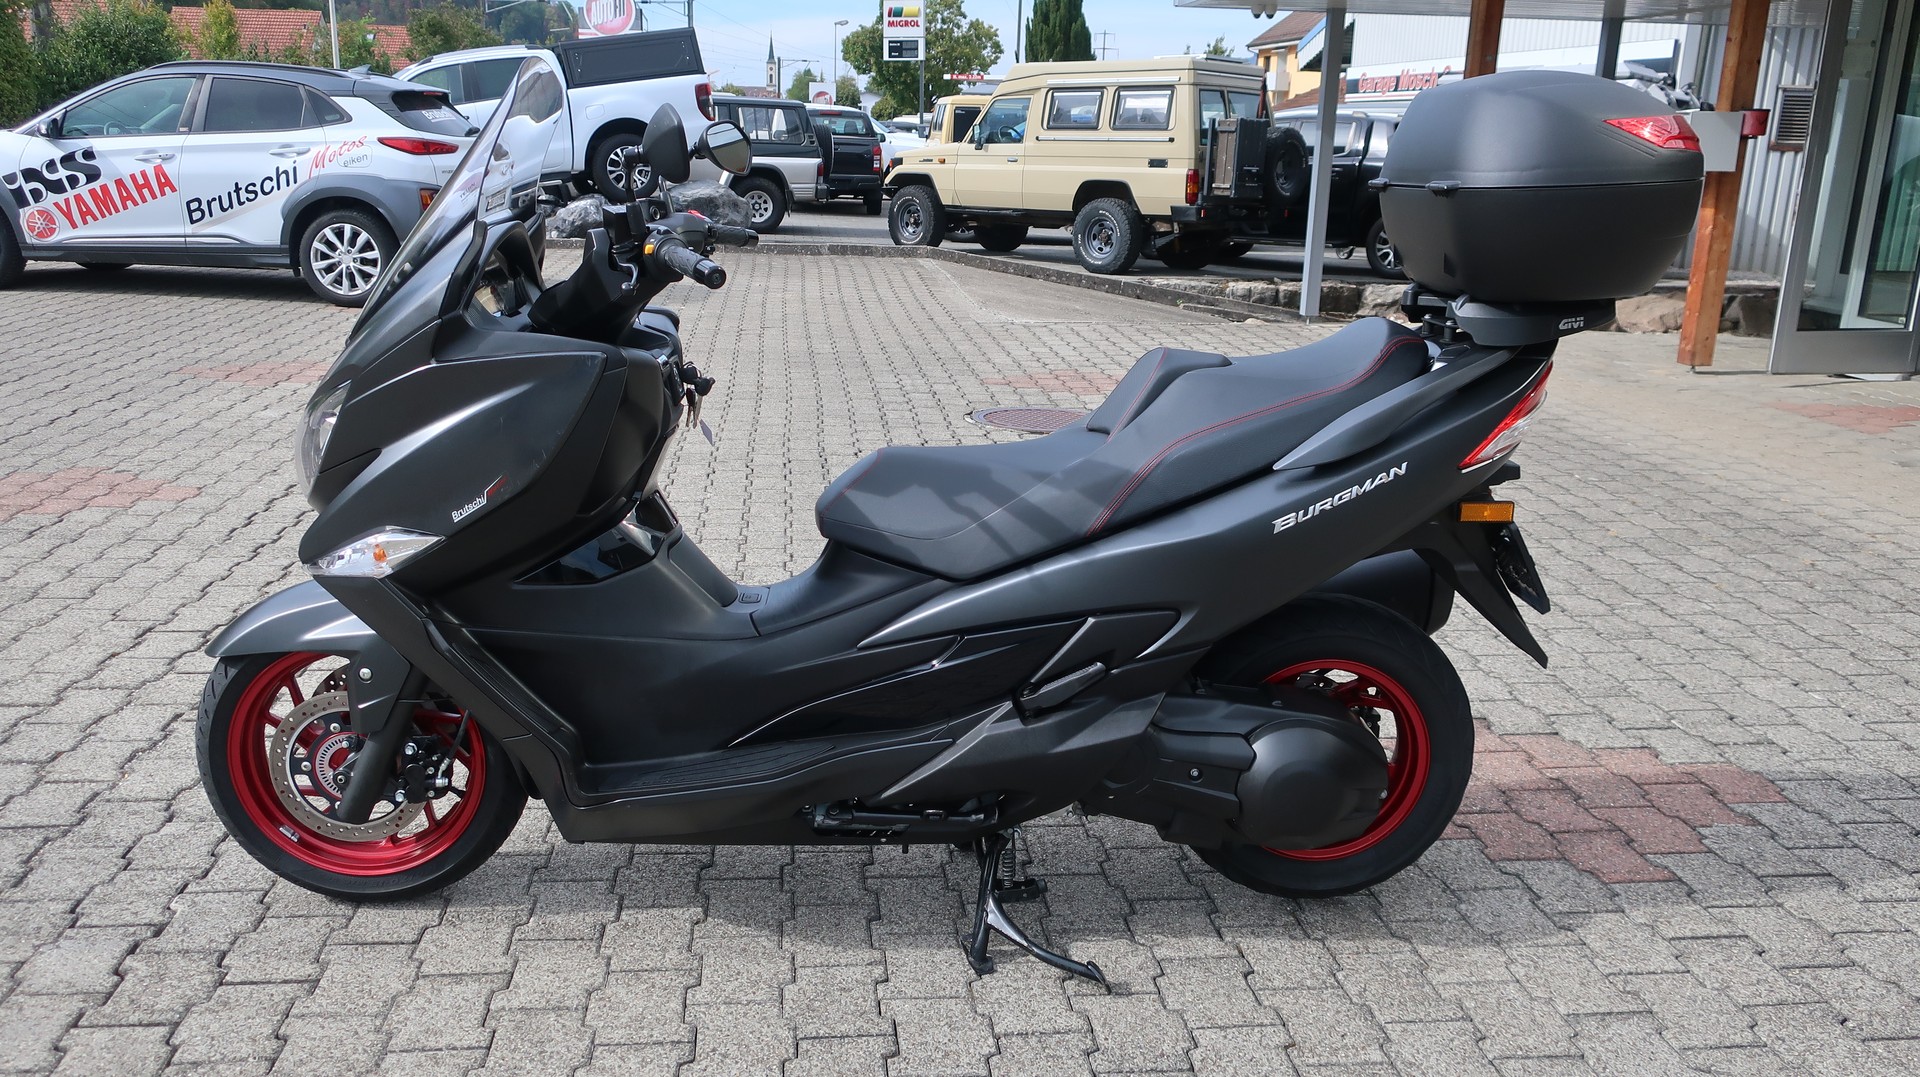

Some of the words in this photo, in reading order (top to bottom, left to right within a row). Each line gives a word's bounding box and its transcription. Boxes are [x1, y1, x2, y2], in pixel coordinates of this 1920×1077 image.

[887, 20, 921, 28] MIGROL
[1358, 72, 1397, 95] Garage
[309, 136, 368, 179] Motos
[343, 153, 369, 168] eiken
[53, 163, 178, 229] YAMAHA
[185, 160, 299, 225] Brutschi
[1559, 316, 1585, 330] GIVI
[451, 494, 485, 520] Brutschi
[1271, 461, 1409, 535] BURGMAN
